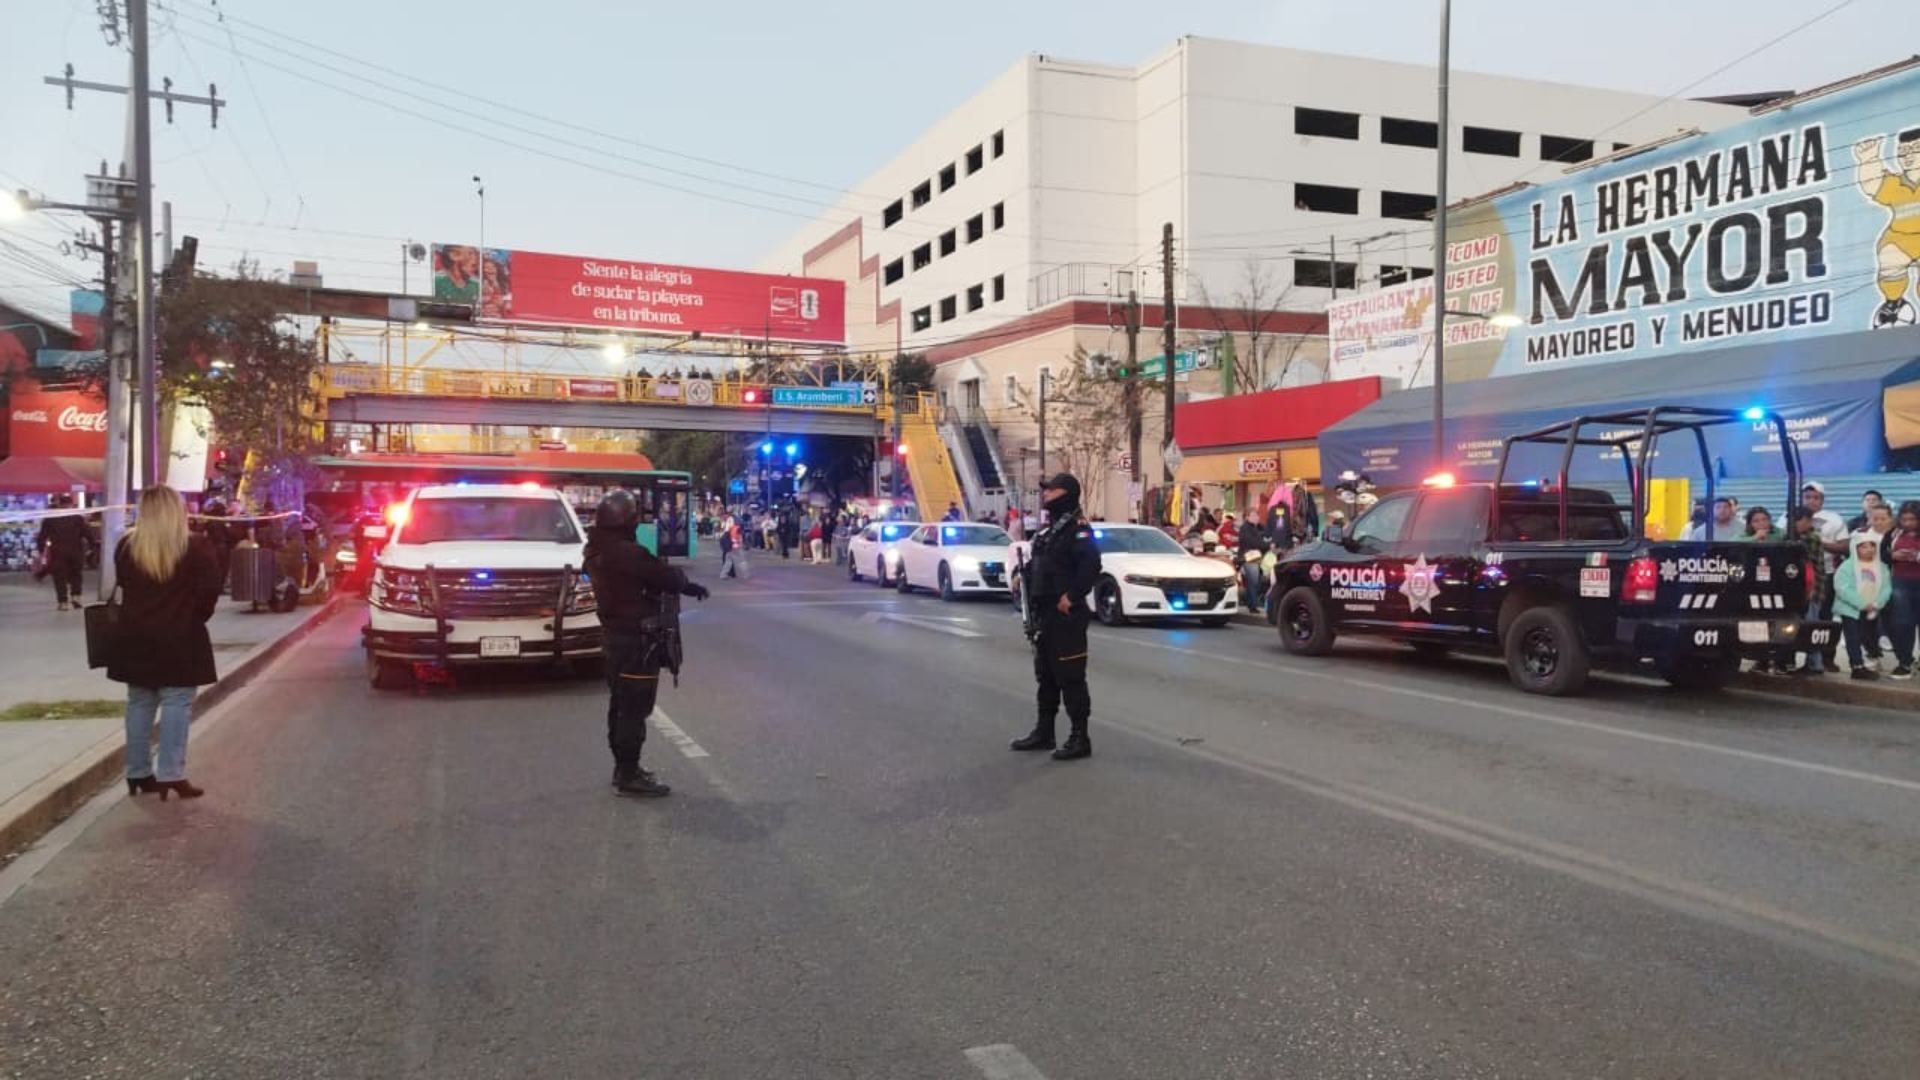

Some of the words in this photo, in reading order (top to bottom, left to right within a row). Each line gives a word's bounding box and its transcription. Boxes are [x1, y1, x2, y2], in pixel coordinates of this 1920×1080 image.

[1532, 194, 1578, 250] LA
[1597, 125, 1827, 234] HERMANA
[1531, 197, 1827, 325] MAYOR
[583, 262, 628, 279] Siente
[630, 265, 643, 280] la
[1446, 265, 1496, 290] USTED
[572, 282, 591, 296] de
[593, 285, 635, 300] sudar
[637, 286, 650, 302] la
[652, 288, 703, 306] playera
[1470, 290, 1502, 312] NOS
[593, 306, 612, 319] en
[614, 306, 627, 320] la
[629, 307, 684, 325] tribuna.
[1527, 322, 1635, 363] MAYOREO
[1652, 317, 1666, 345] Y
[1683, 292, 1831, 342] MENUDEO
[1245, 460, 1277, 472] OXXO
[1485, 552, 1504, 565] 011
[1678, 555, 1728, 572] POLICÍA
[1330, 563, 1386, 588] POLICÍA
[1680, 573, 1728, 583] MONTERREY
[1331, 587, 1386, 601] MONTERREY
[1694, 630, 1719, 646] 011
[1811, 629, 1830, 645] 011
